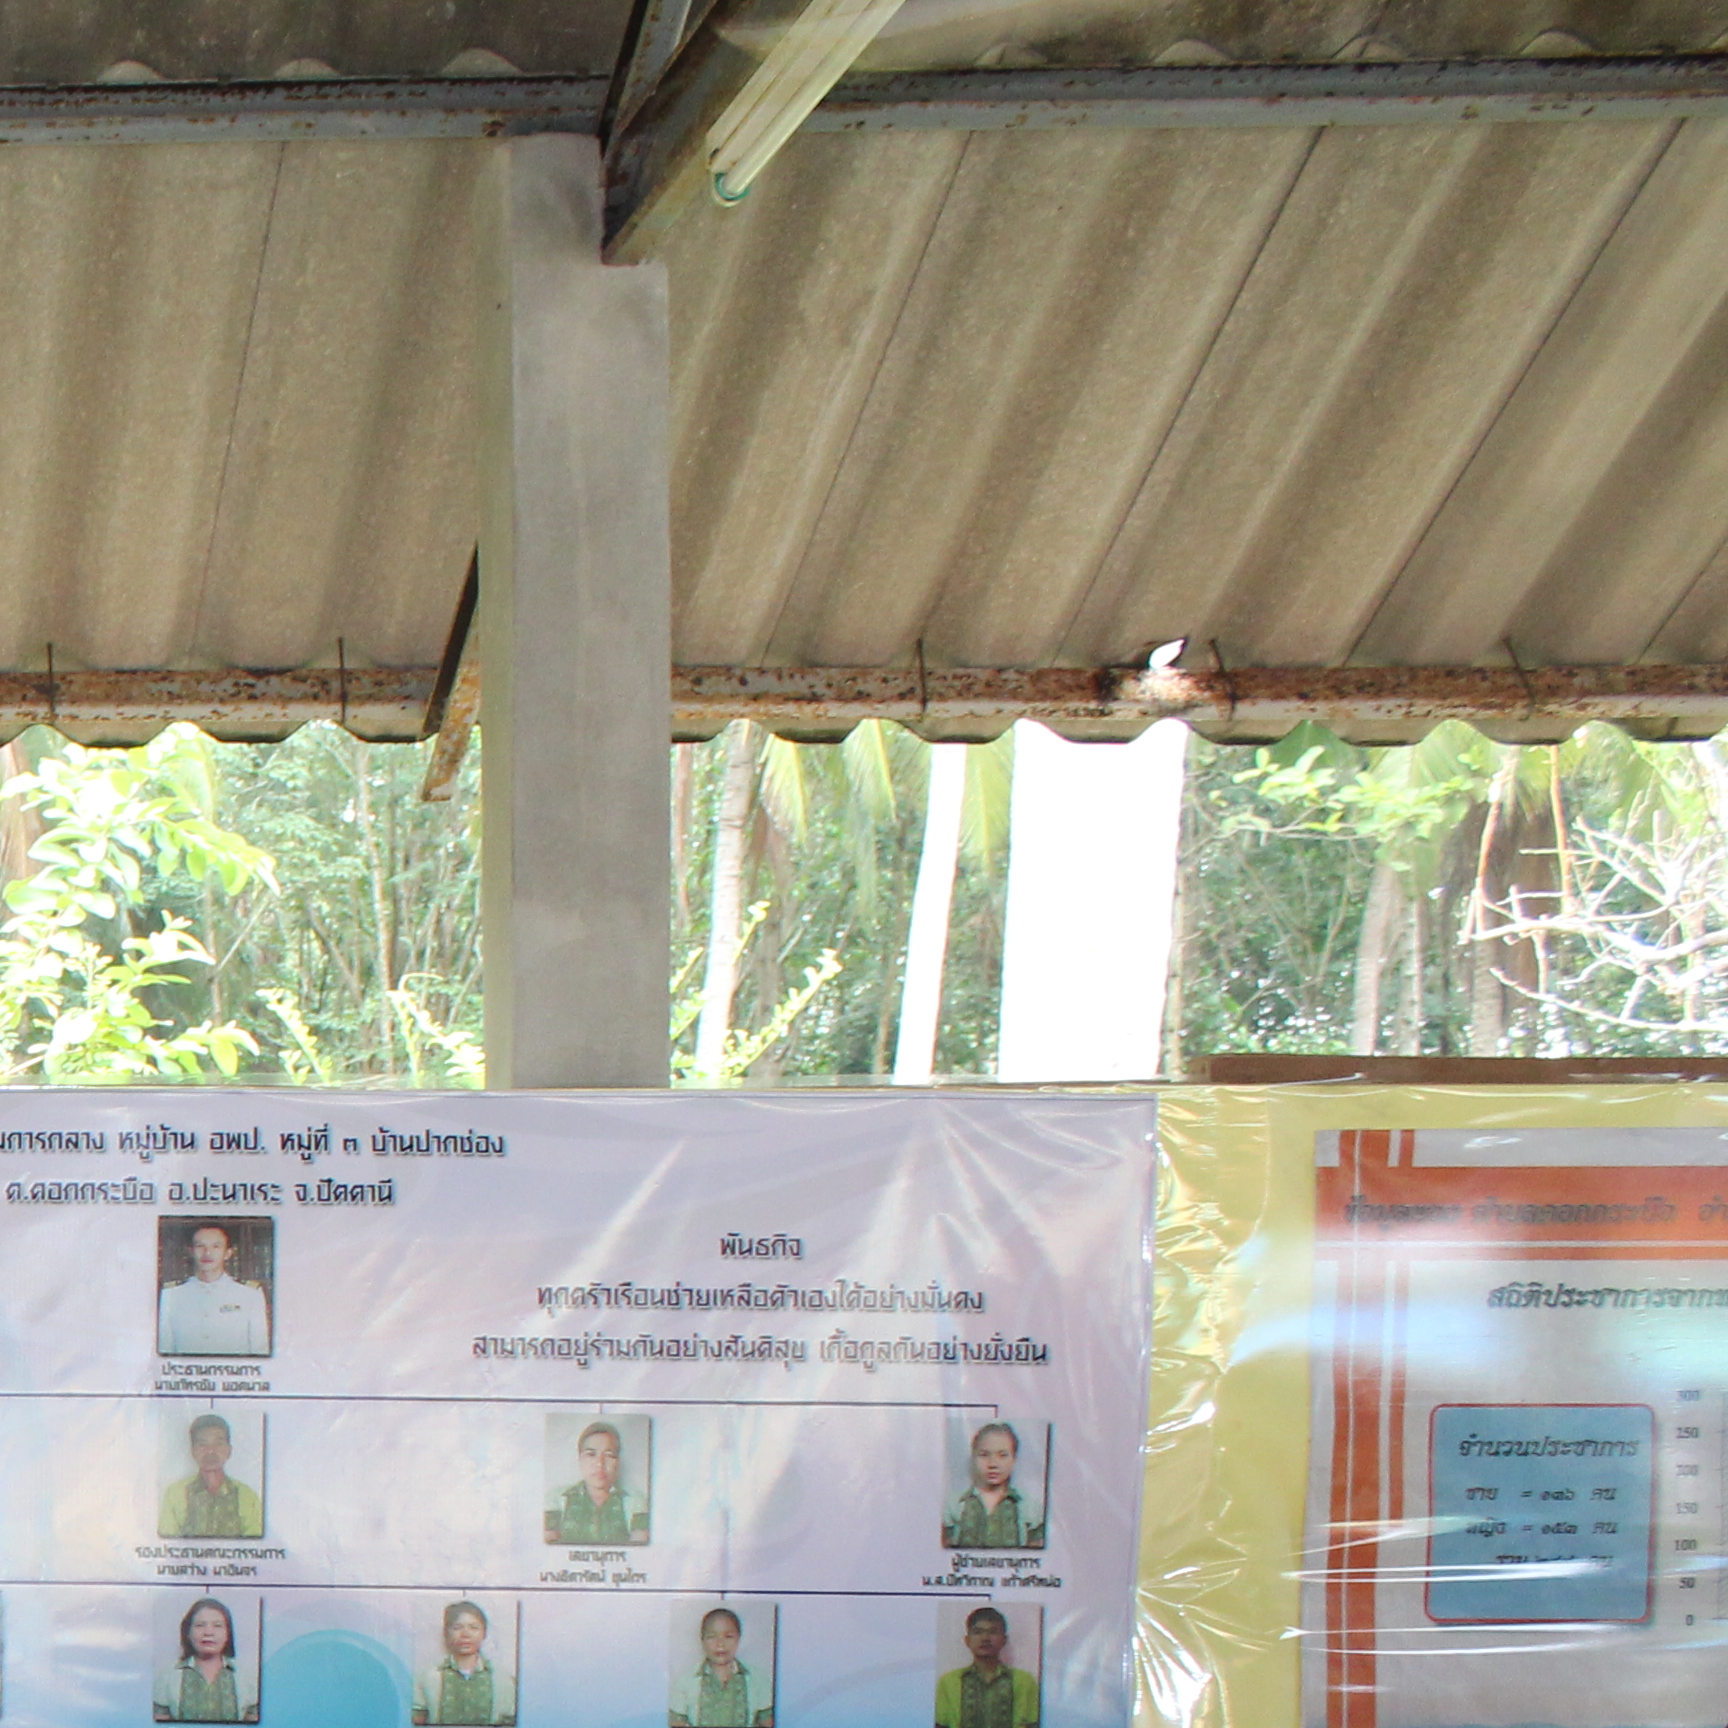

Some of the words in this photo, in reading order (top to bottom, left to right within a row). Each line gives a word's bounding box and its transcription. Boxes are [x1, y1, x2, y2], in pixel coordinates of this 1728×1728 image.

[118, 1123, 195, 1163] หมู่บ้าน
[209, 1128, 266, 1152] อพป.
[280, 1122, 330, 1163] หมู่ที่
[370, 1124, 505, 1157] บ้านปากช่อง
[5, 1176, 154, 1203] ต.คอกกระบือ
[168, 1177, 282, 1203] อ.ปะนาเระ
[294, 1177, 393, 1205] จ.ปัตตานี
[719, 1232, 803, 1259] พันธกิจ
[1676, 1427, 1699, 1439] 250
